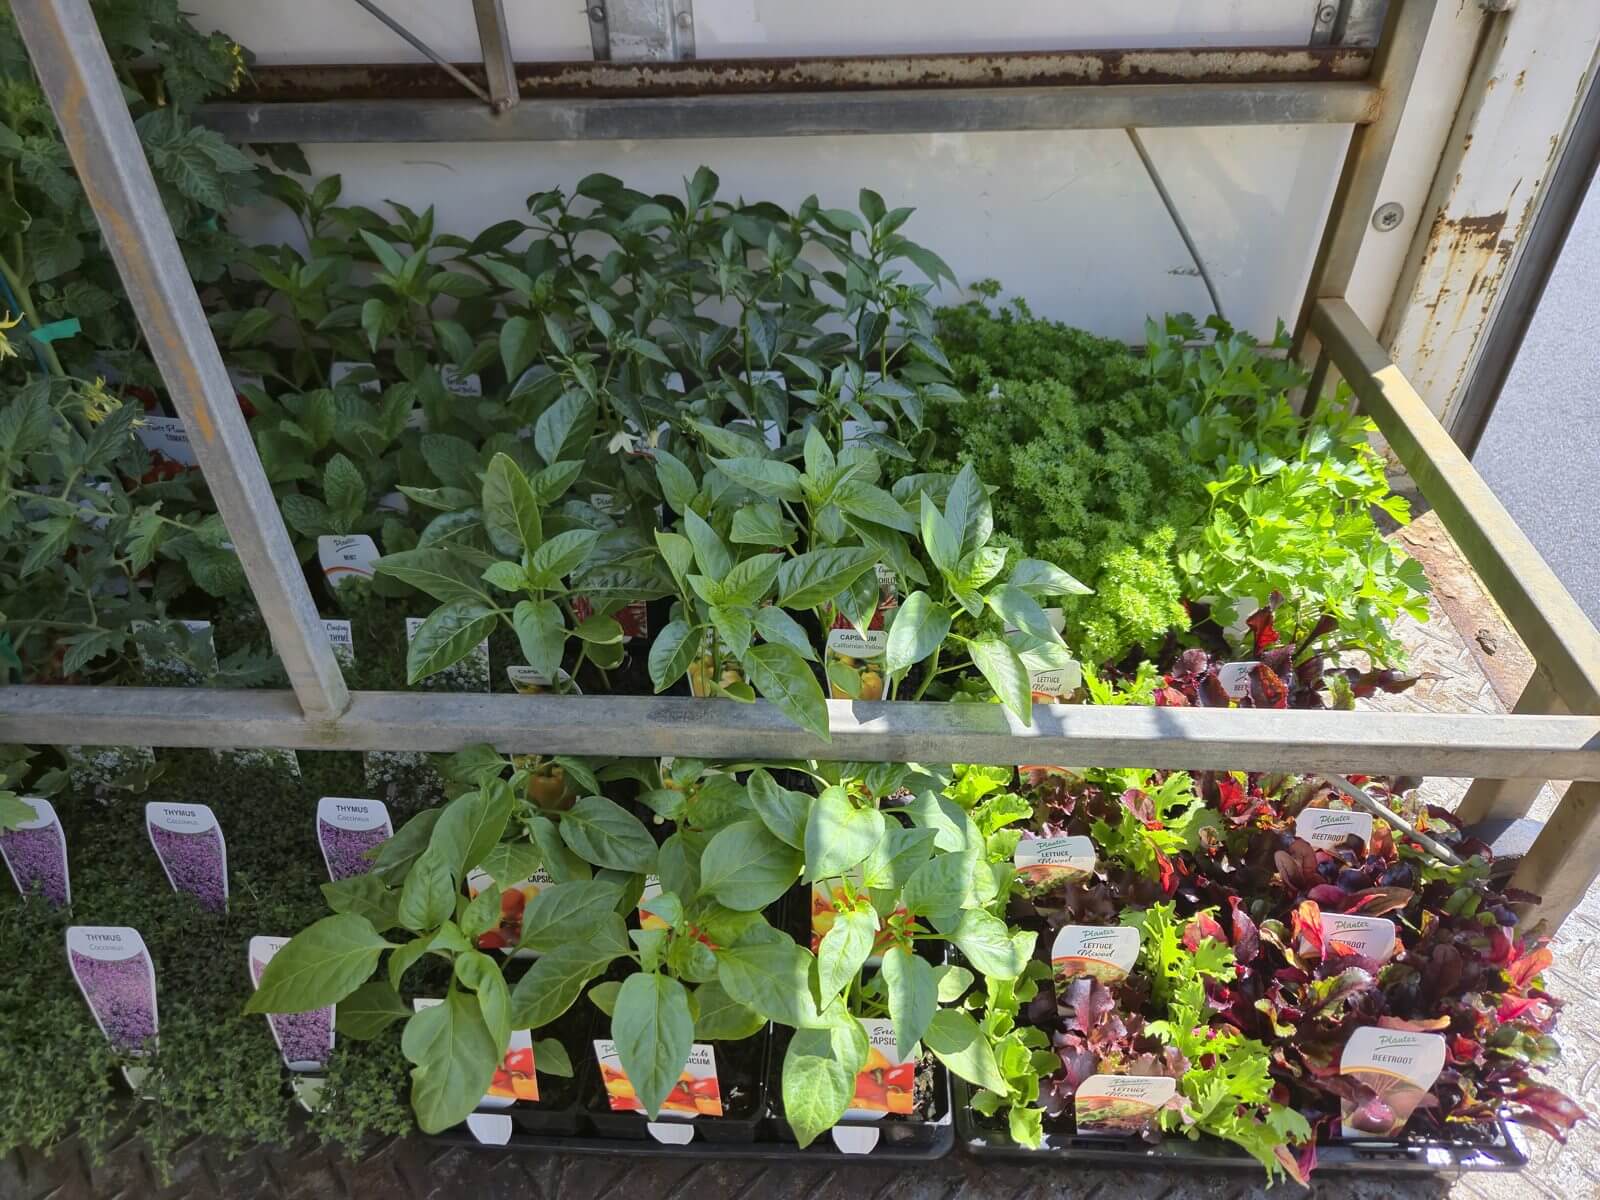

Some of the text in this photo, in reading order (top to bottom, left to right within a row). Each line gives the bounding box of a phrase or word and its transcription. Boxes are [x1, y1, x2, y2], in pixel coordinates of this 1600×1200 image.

[163, 808, 196, 817] THYMUS
[336, 804, 369, 813] THYMUS
[1312, 833, 1346, 842] BEETROOT
[870, 1036, 897, 1046] CAPSIC
[1372, 1051, 1414, 1064] BEETROOT
